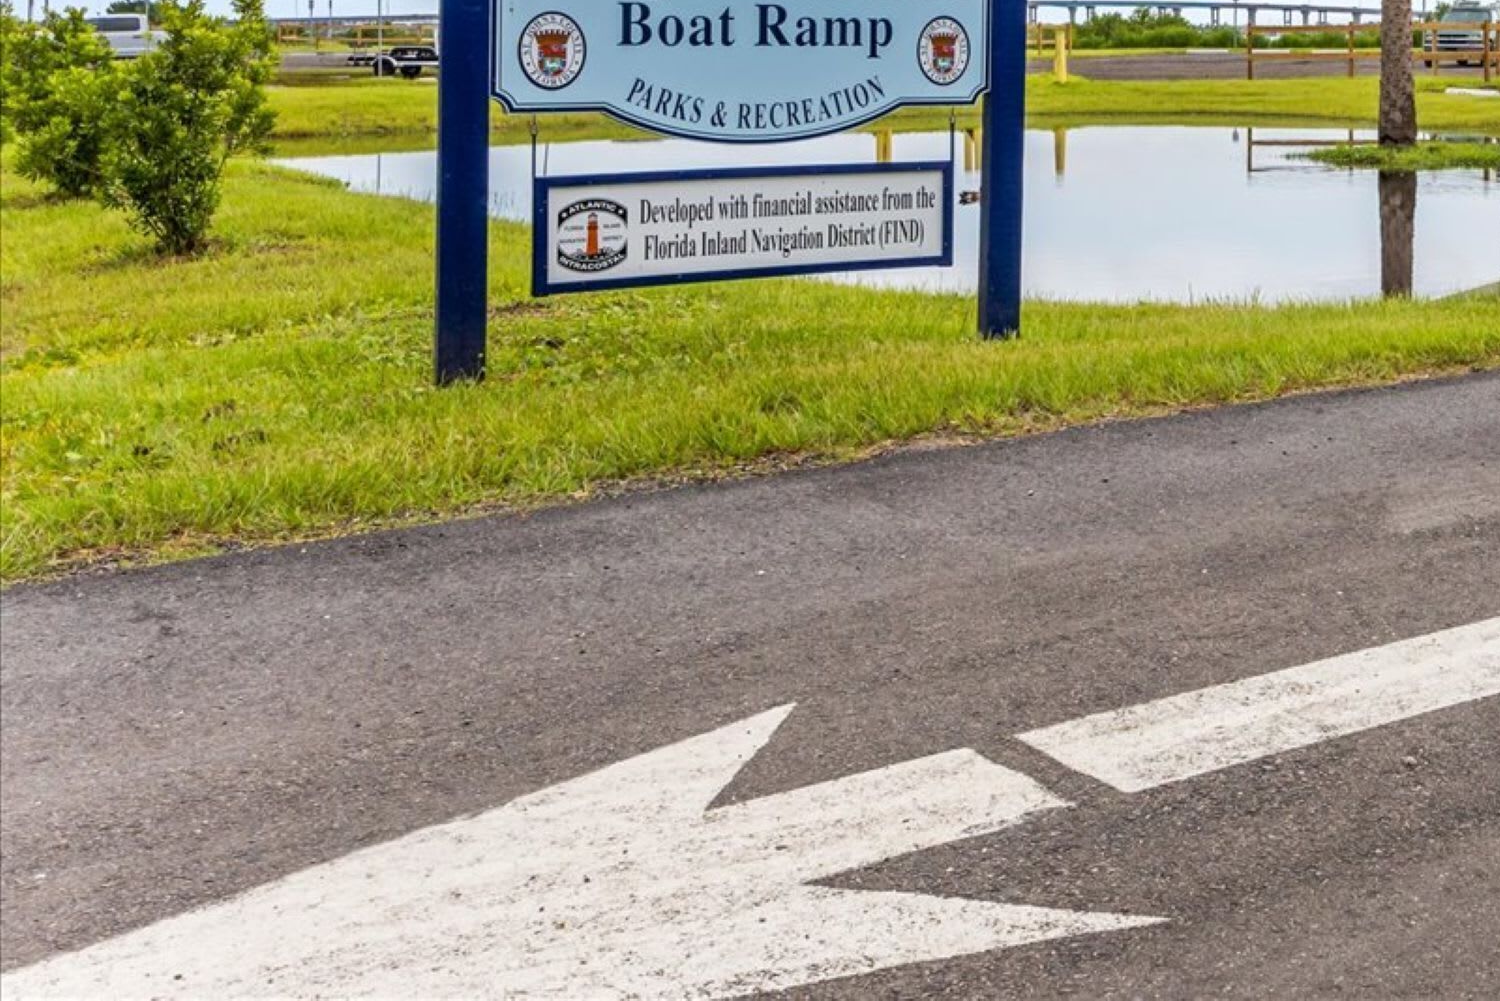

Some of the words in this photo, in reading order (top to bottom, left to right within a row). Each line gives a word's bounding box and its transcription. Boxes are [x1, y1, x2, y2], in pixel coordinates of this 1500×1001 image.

[617, 2, 735, 48] Boat
[753, 4, 894, 58] Ramp
[626, 77, 705, 124] PARKS
[710, 101, 728, 128] &
[736, 74, 887, 129] RECREATION
[640, 195, 714, 229] Developed
[719, 193, 748, 219] with
[753, 190, 812, 218] financial
[814, 189, 880, 215] assistance
[882, 186, 914, 211] from
[916, 185, 936, 208] the
[644, 233, 696, 260] Florida
[702, 229, 747, 256] Inland
[751, 224, 824, 259] Navigation
[828, 222, 876, 248] District
[879, 218, 925, 250] (FIND)
